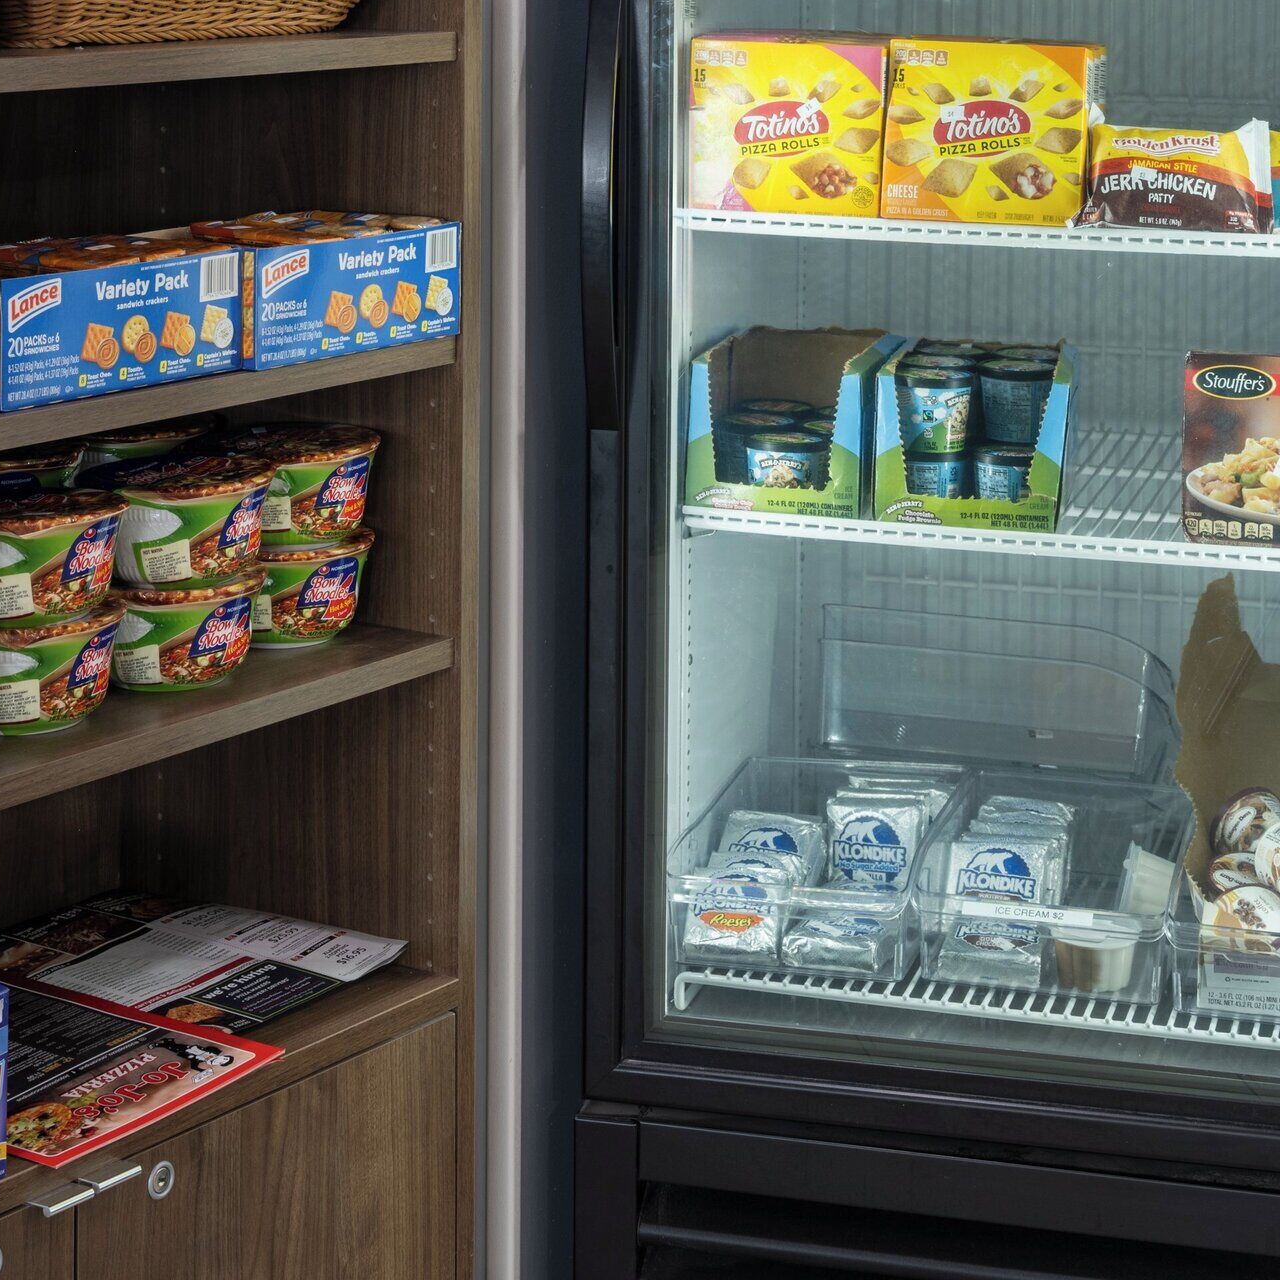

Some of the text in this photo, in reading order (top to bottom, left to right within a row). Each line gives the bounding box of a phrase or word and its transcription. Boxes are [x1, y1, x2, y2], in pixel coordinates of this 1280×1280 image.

[743, 112, 821, 141] Totino's
[741, 137, 820, 156] PIZZA ROLLS
[96, 270, 188, 301] Variety Pack
[264, 255, 307, 288] Lance
[11, 284, 59, 322] Lance
[117, 296, 169, 310] sandwich crackers
[8, 337, 23, 357] 20
[24, 335, 47, 347] PACKS
[55, 333, 59, 343] 6
[24, 344, 59, 356] SANDWICHES
[1203, 372, 1266, 393] Stouffer's
[834, 842, 906, 870] KLONDIKE
[956, 869, 1035, 899] KLONDIKE
[995, 906, 1064, 921] ICE CREAM $2
[237, 964, 277, 985] hiring
[61, 1052, 158, 1099] PIZZERIA
[73, 1061, 188, 1119] Jo-Jo's
